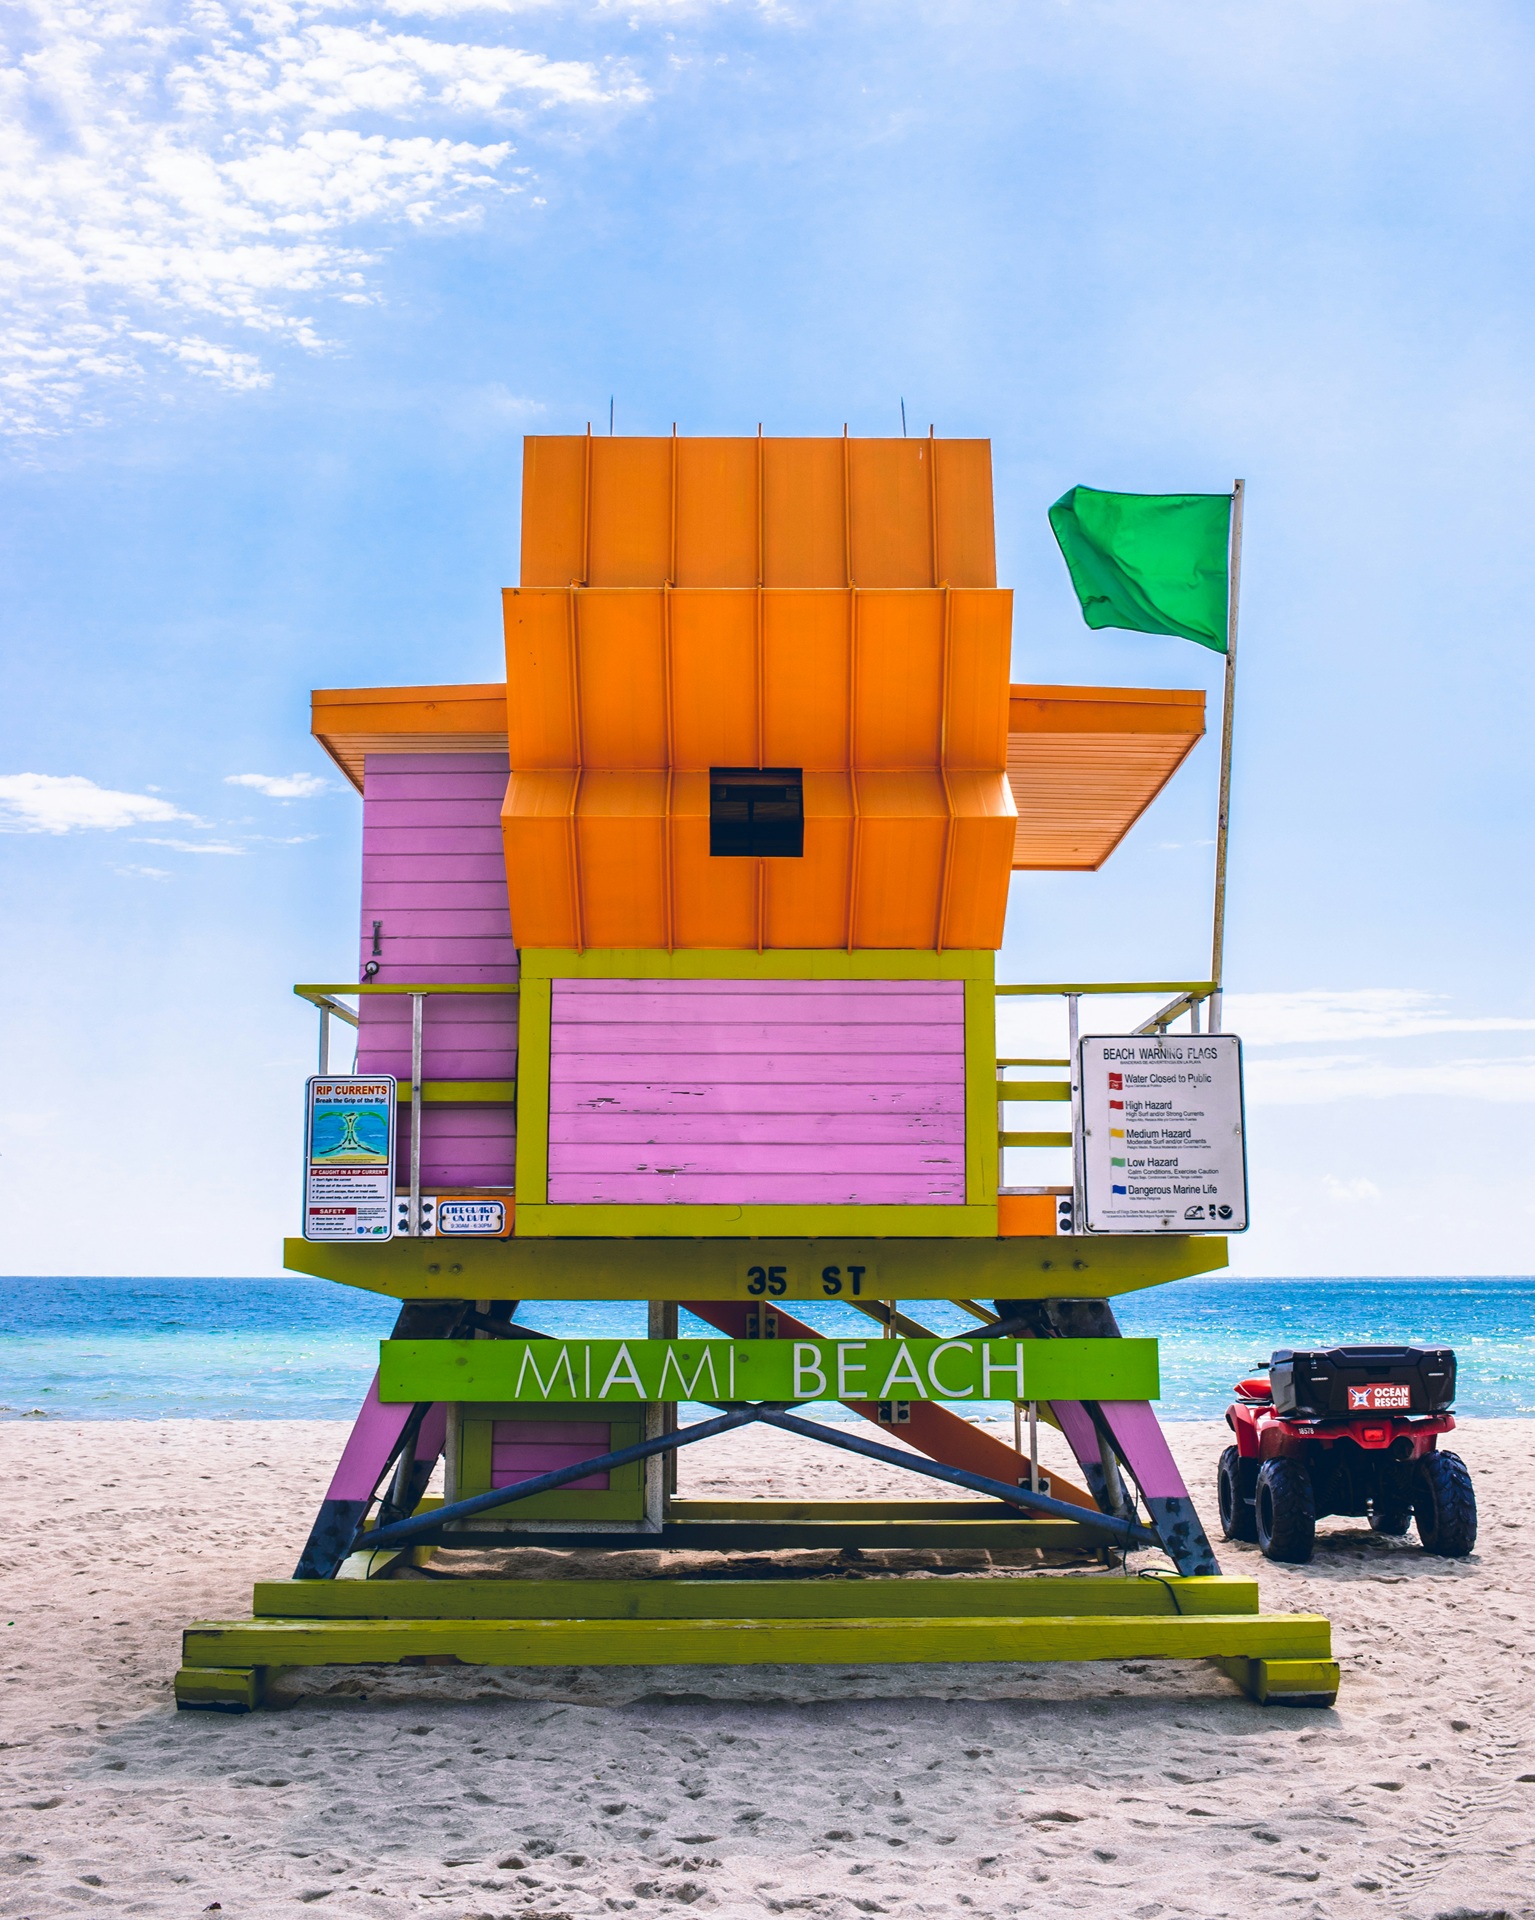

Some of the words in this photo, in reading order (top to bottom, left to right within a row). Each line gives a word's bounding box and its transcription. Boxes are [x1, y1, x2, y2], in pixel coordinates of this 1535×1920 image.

[1103, 1048, 1134, 1060] BEACH
[1139, 1048, 1182, 1060] WARNING
[1188, 1048, 1217, 1060] FLAGS
[1125, 1074, 1148, 1083] Water
[1150, 1074, 1176, 1083] Closed
[1179, 1074, 1186, 1083] to
[1188, 1074, 1212, 1083] Public
[316, 1086, 332, 1095] RIP
[335, 1086, 387, 1095] CURRENTS
[1126, 1101, 1143, 1111] High
[1145, 1101, 1172, 1109] Hazard
[1126, 1129, 1159, 1138] Medium
[1161, 1129, 1191, 1138] Hazard
[1127, 1158, 1145, 1166] Low
[1148, 1158, 1178, 1166] Hazard
[1128, 1185, 1171, 1196] Dangerous
[1173, 1185, 1200, 1194] Marine
[1202, 1185, 1217, 1194] Life
[747, 1266, 787, 1295] 35
[822, 1266, 866, 1295] ST
[514, 1341, 734, 1399] MIAMI
[793, 1341, 1024, 1399] BEACH
[1374, 1388, 1408, 1397] OCEAN
[1374, 1397, 1409, 1407] RESCUE
